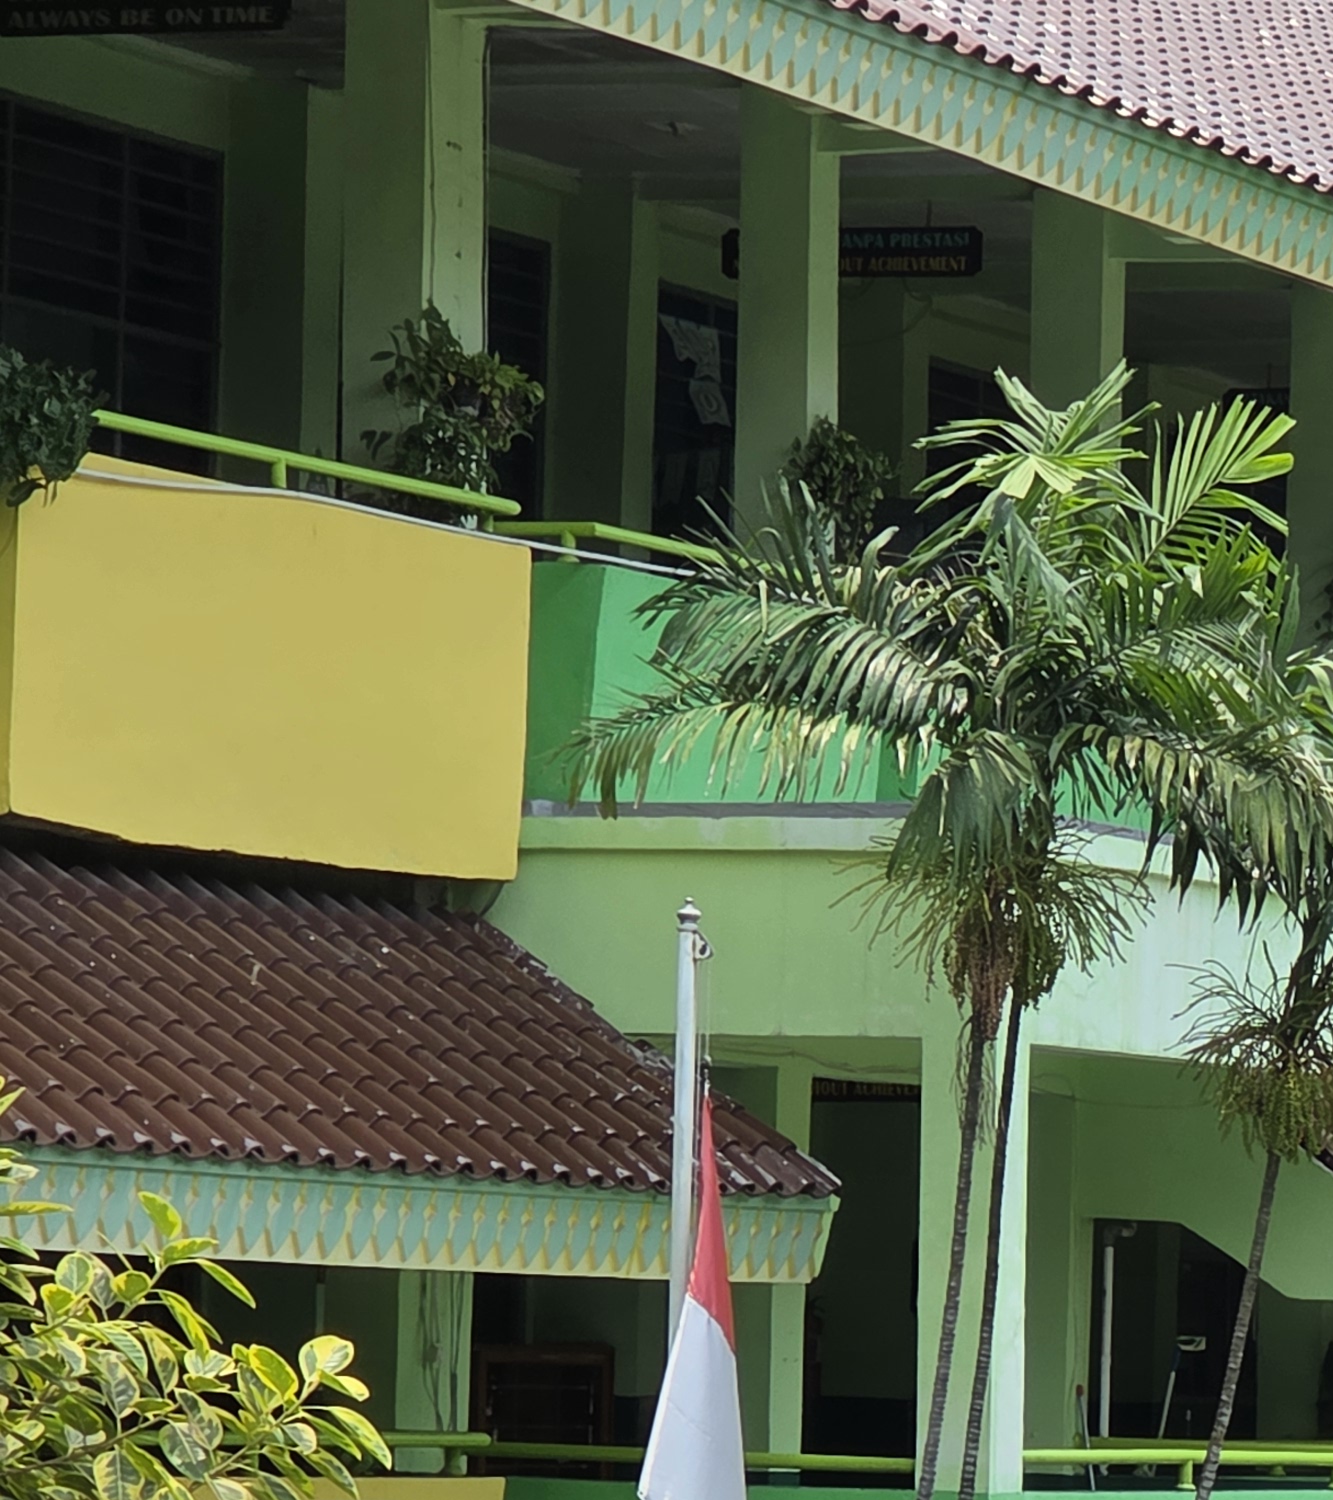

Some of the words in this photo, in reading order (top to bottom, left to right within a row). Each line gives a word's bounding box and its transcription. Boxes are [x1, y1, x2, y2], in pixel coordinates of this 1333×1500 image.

[8, 10, 111, 29] ALWAYS
[119, 8, 156, 26] BE
[165, 8, 203, 25] ON
[210, 6, 275, 24] TIME
[842, 233, 884, 249] ANPA
[890, 231, 970, 248] PRESTASI
[868, 255, 967, 272] ACHIEVEMENT
